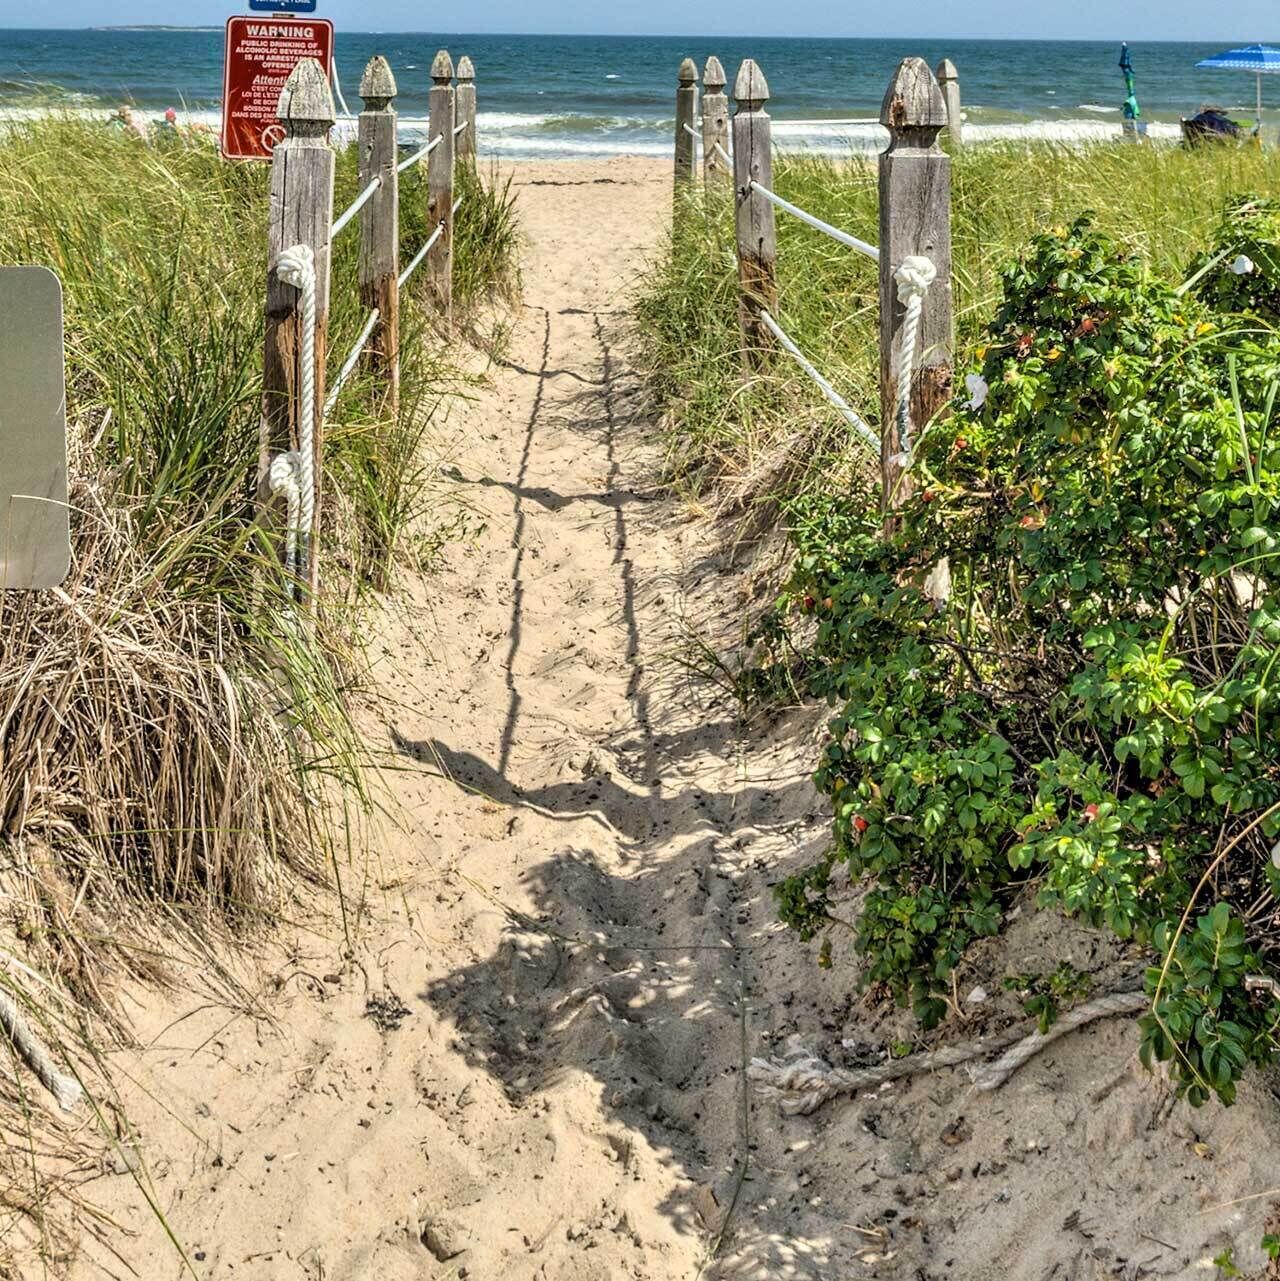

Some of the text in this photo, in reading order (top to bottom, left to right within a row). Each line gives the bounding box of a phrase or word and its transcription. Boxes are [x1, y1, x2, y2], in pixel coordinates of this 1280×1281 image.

[246, 25, 314, 38] WARNING
[279, 48, 323, 56] BEVERAGES
[261, 61, 295, 69] OFFENSE
[252, 74, 288, 85] Attenti
